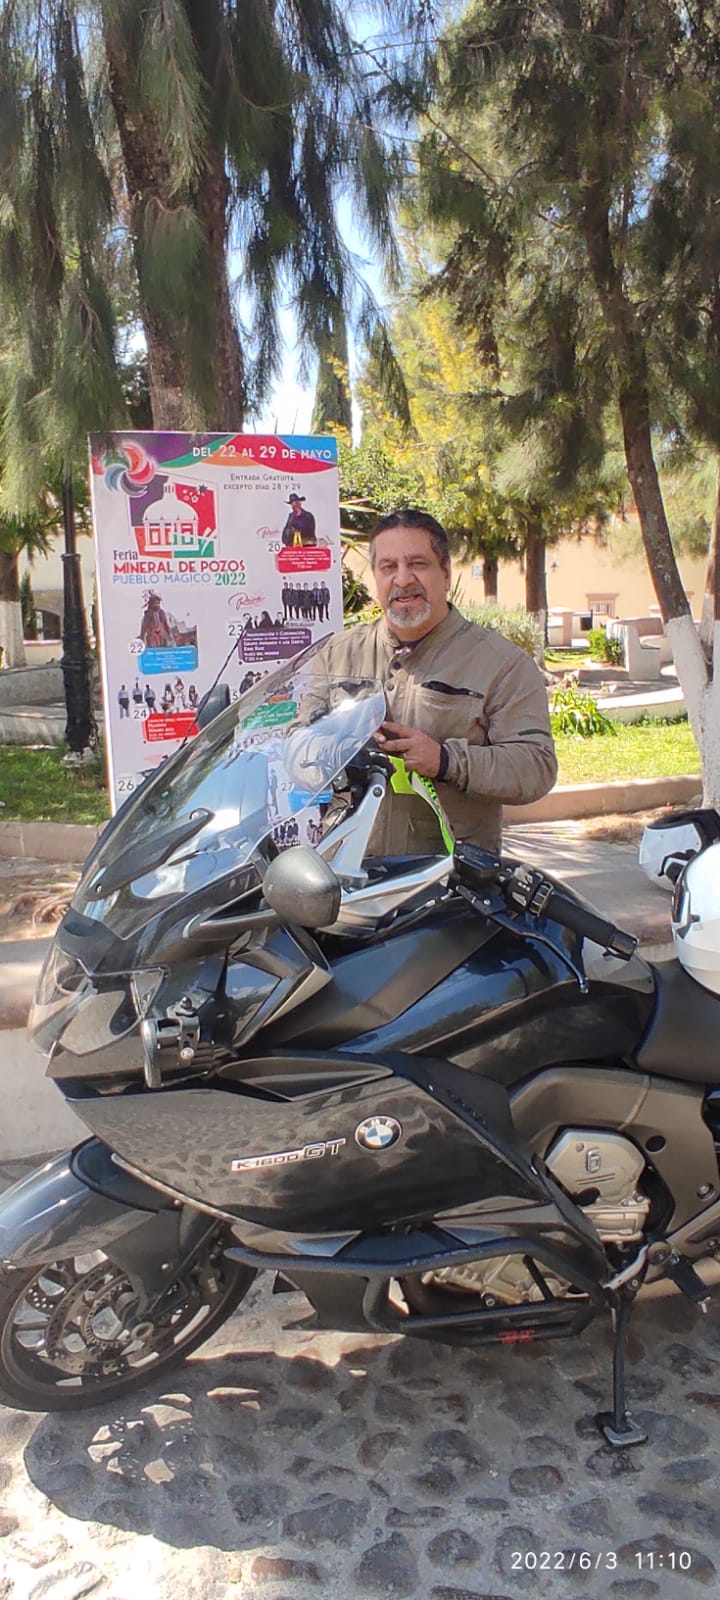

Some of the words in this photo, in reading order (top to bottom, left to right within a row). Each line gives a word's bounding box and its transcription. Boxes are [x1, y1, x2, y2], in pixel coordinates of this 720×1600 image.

[192, 447, 213, 457] DEL
[219, 445, 237, 458] 22
[242, 450, 256, 458] AL
[259, 446, 277, 459] 29
[282, 451, 297, 459] DE
[301, 450, 332, 459] MAYO
[268, 543, 281, 552] 20
[113, 549, 139, 560] Feria
[113, 561, 174, 574] MINERAL
[178, 560, 197, 573] DE
[200, 559, 246, 573] POZOS
[112, 573, 160, 585] PUEBLO
[164, 572, 212, 584] MÁGICO
[214, 572, 247, 586] 2022
[130, 642, 144, 654] 22
[134, 709, 147, 719] 24
[118, 780, 135, 791] 26
